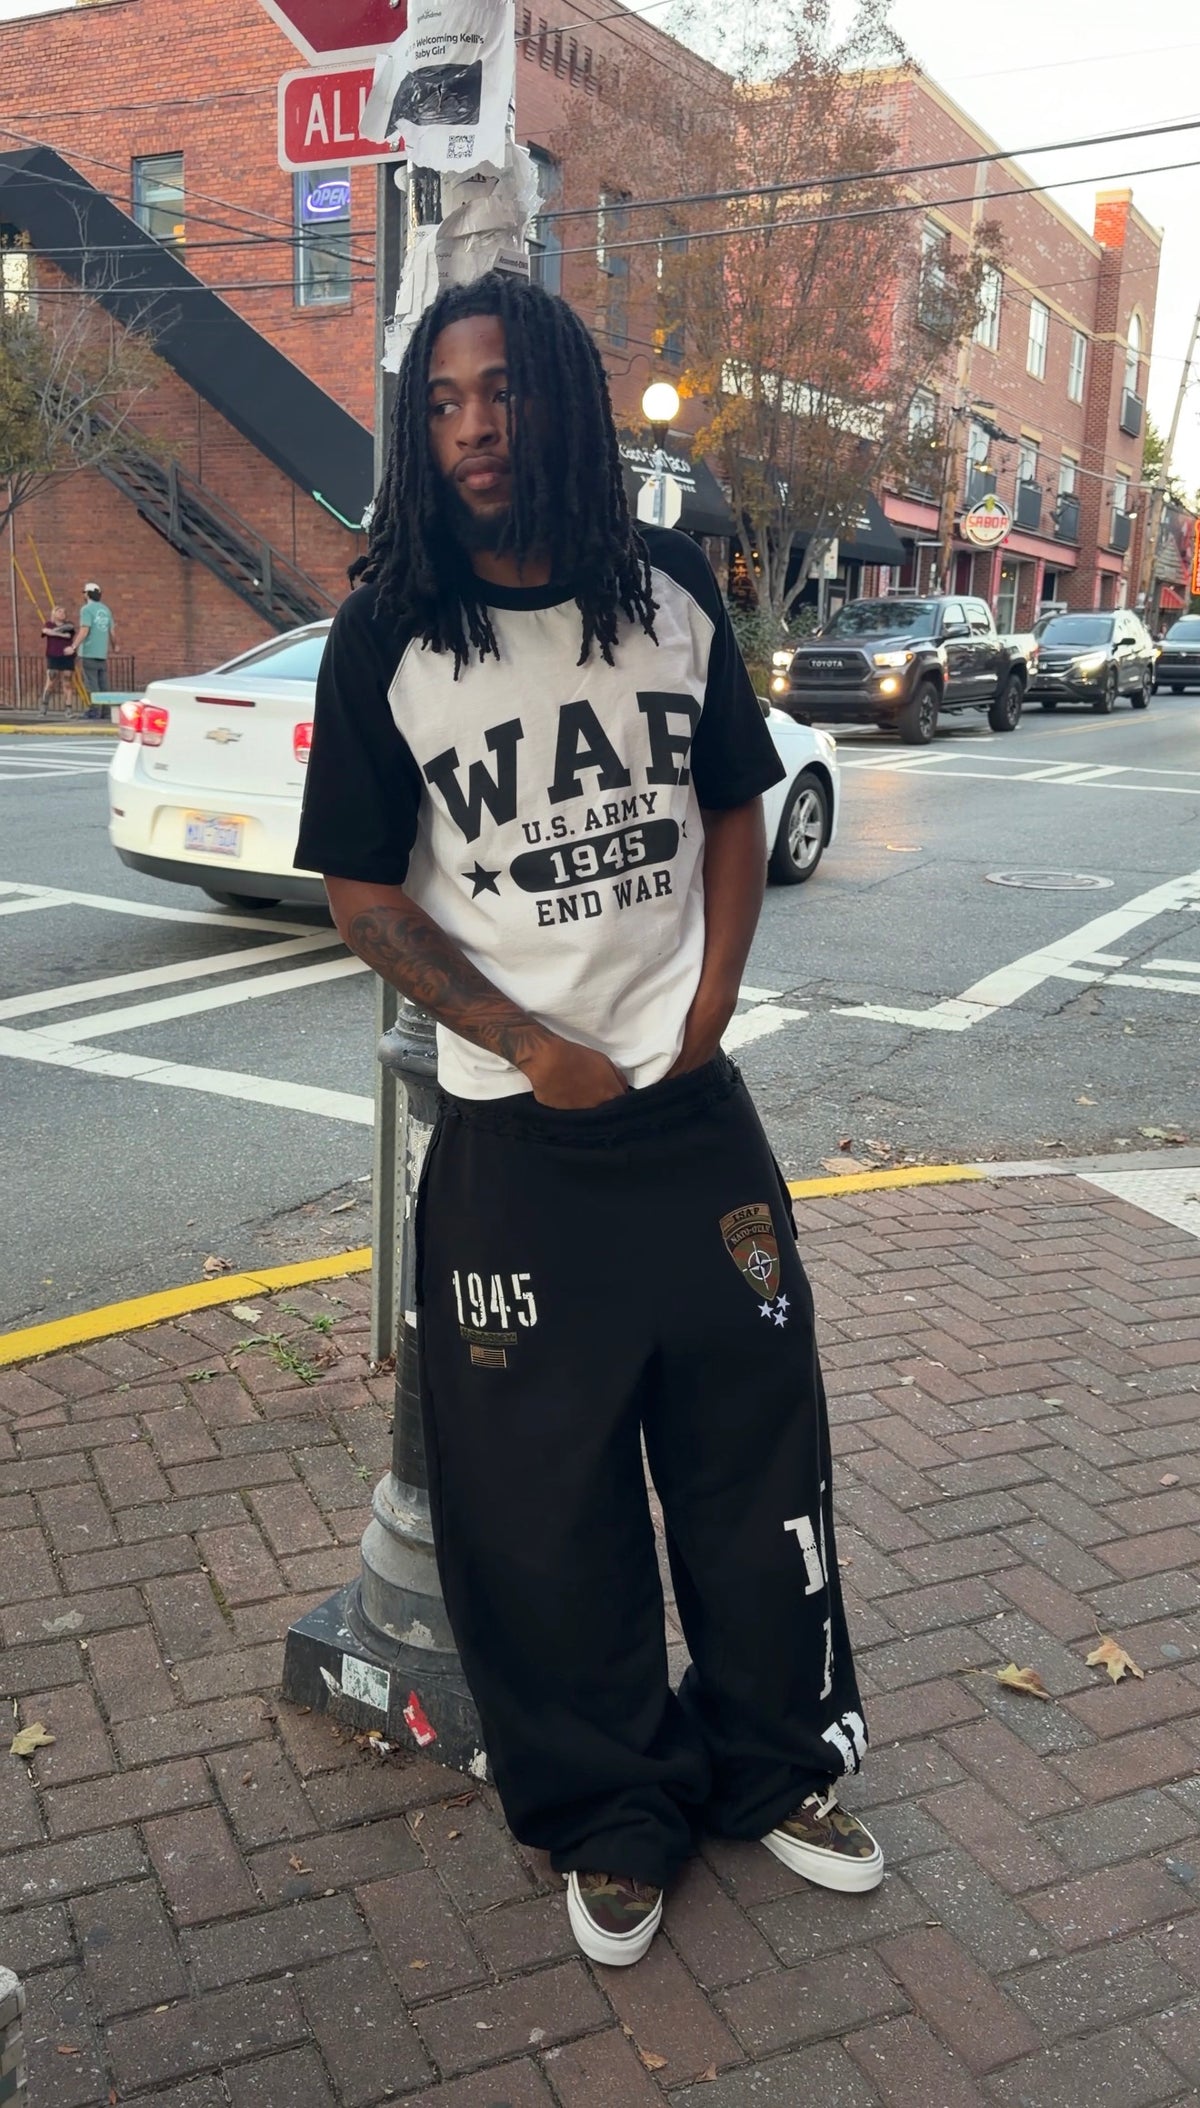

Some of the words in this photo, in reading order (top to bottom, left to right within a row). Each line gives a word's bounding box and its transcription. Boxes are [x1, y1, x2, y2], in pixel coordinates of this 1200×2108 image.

[416, 33, 459, 48] Welcoming
[432, 45, 446, 56] Girl
[311, 188, 349, 206] OPEN
[968, 515, 1008, 529] SABOR
[811, 660, 843, 668] TOYOTA
[422, 691, 702, 844] WAR
[522, 815, 575, 844] U.S.
[584, 791, 658, 831] ARMY
[550, 829, 646, 884] 1945
[535, 890, 603, 927] END
[612, 869, 673, 910] WAR
[452, 1270, 538, 1329] 1945
